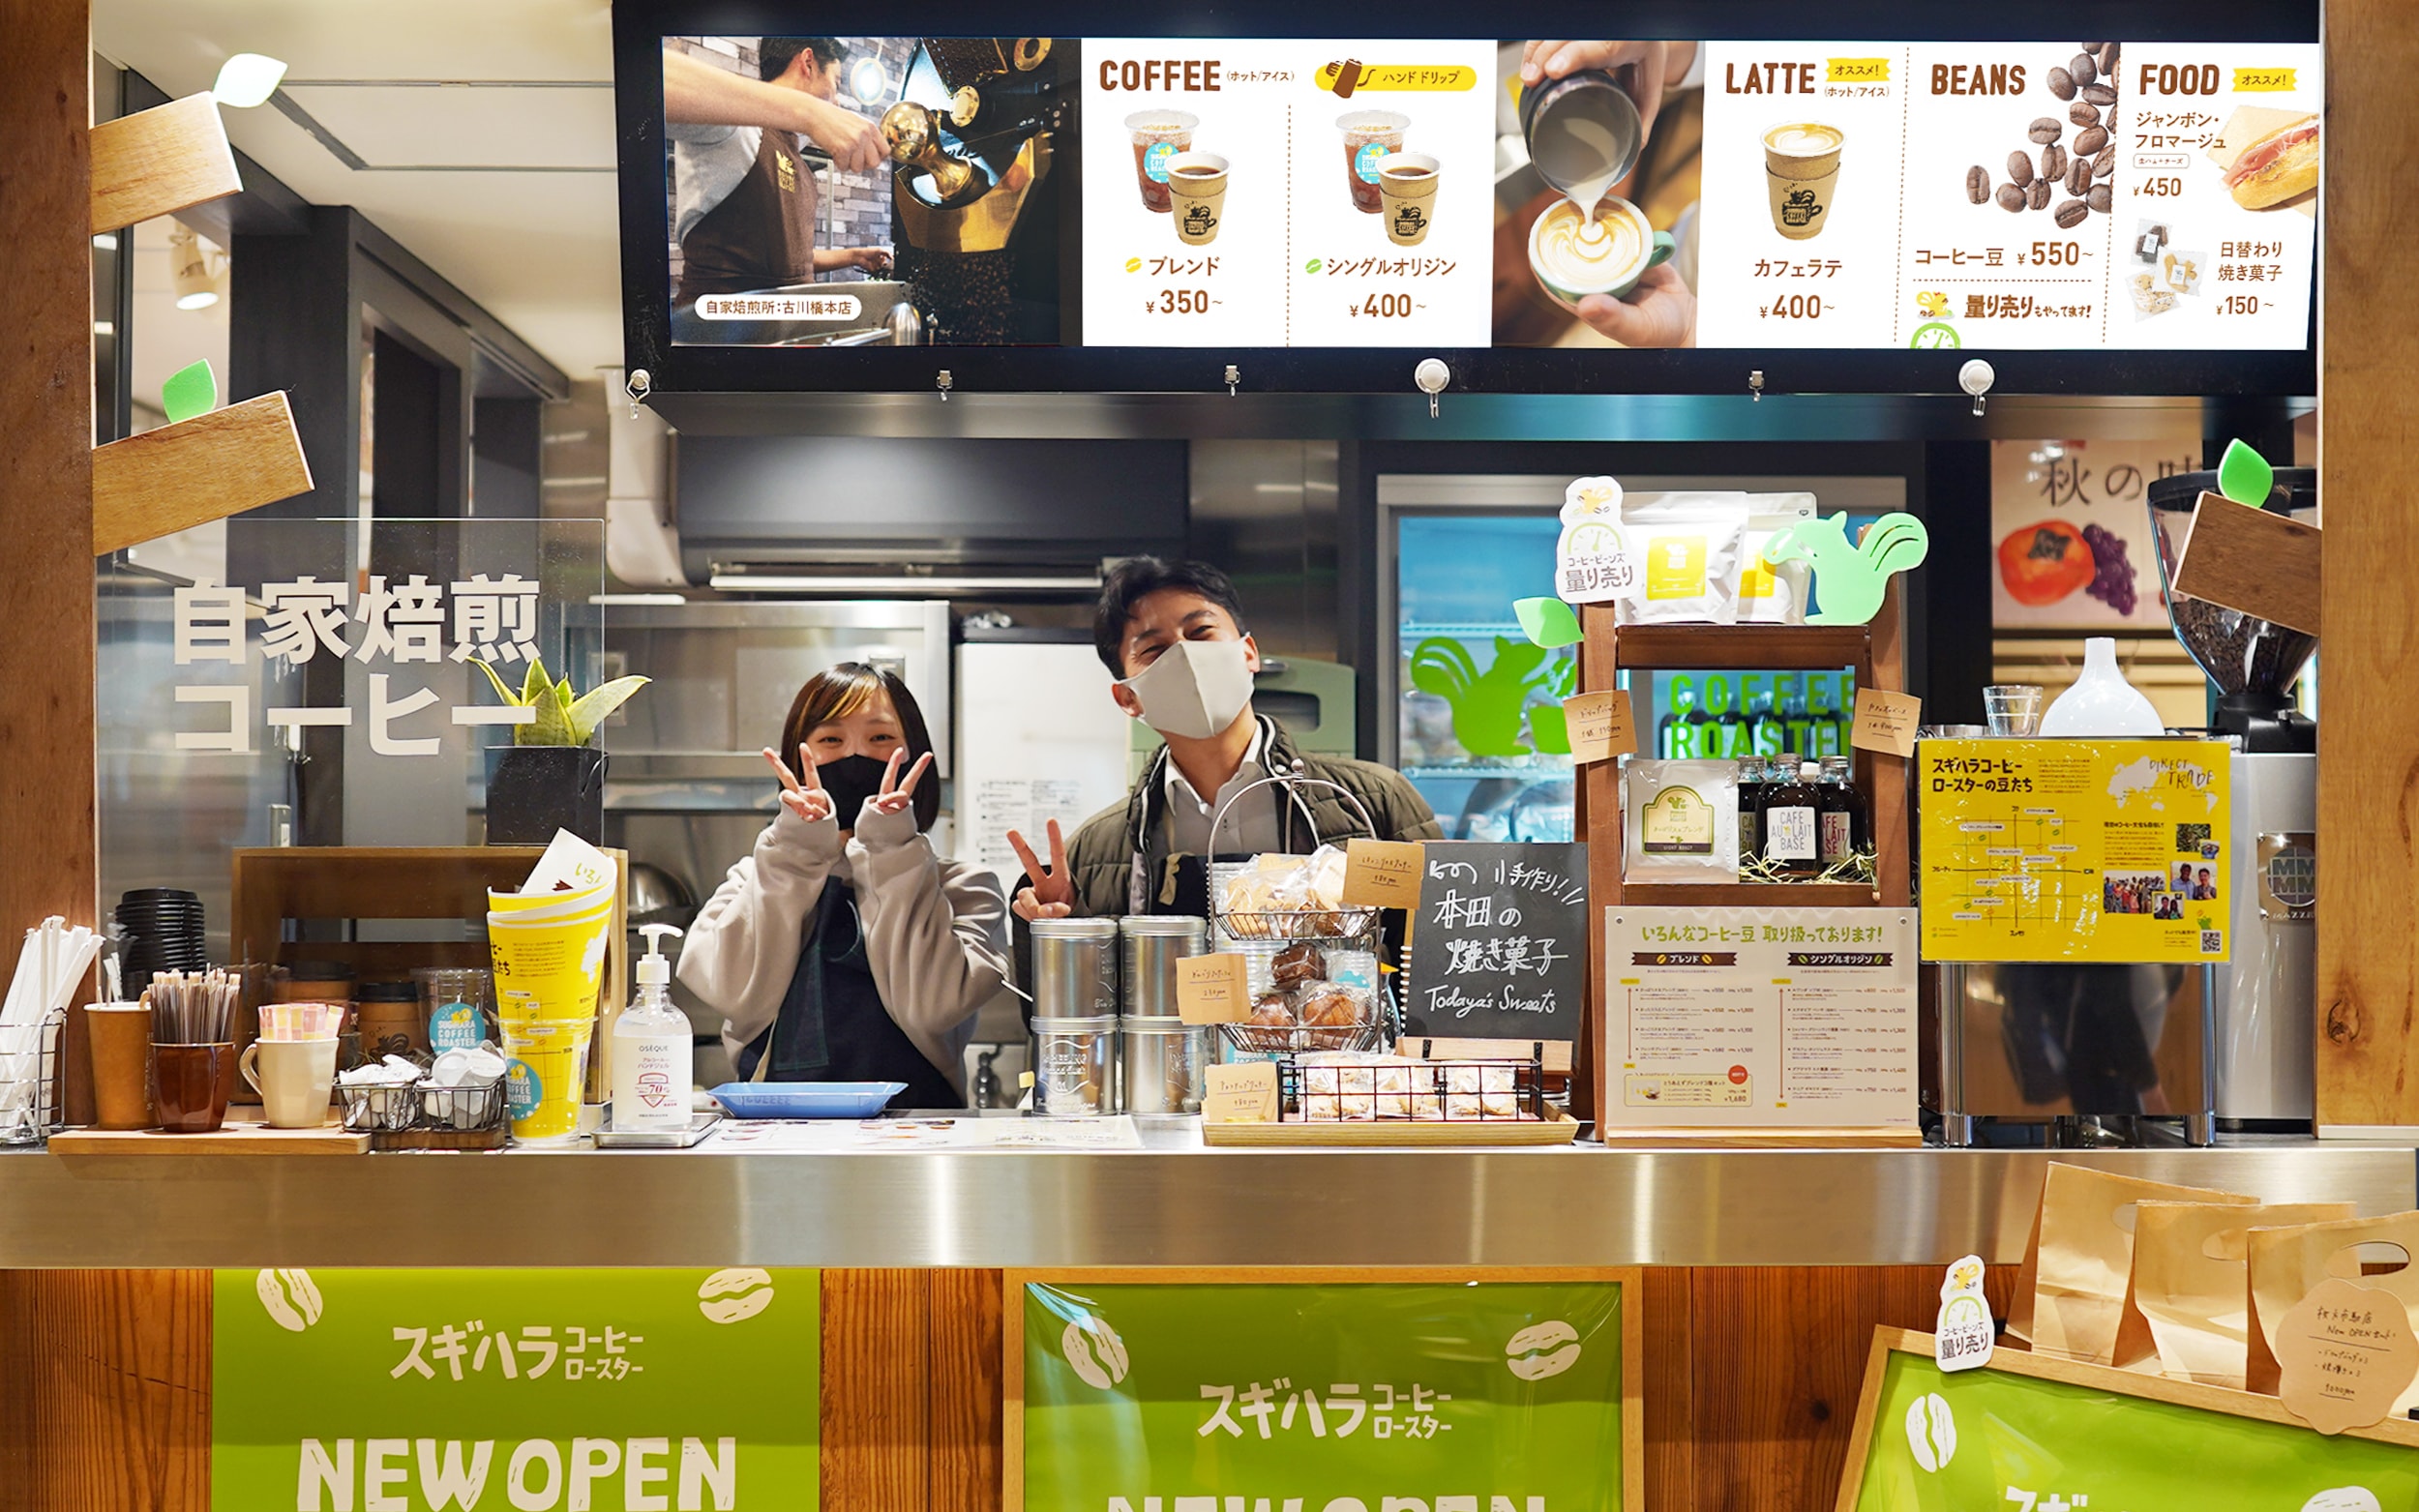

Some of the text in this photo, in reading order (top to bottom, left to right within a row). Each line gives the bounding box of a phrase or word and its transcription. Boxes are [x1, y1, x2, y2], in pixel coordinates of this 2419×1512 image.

[1100, 60, 1221, 92] COFFEE
[1725, 62, 1816, 95] LATTE
[1931, 64, 2026, 96] BEANS
[2139, 64, 2221, 96] FOOD
[2135, 133, 2226, 149] フロマージュ
[1915, 248, 2005, 266] コーヒー豆
[2221, 241, 2284, 258] 日替わり
[1148, 256, 1220, 277] ブレンド
[1327, 256, 1457, 278] シングルオリジン
[1753, 258, 1843, 279] カフェラテ
[2217, 264, 2284, 282] 焼き菓子
[1565, 565, 1633, 593] 量り売り
[173, 574, 541, 666] 自家焙煎
[174, 673, 537, 756] コーヒー
[1932, 757, 2023, 774] スギハラコーヒー
[2149, 758, 2189, 772] DIRECT
[1931, 777, 2033, 793] ロースターの豆たち
[1779, 811, 1805, 824] CAFE
[1792, 824, 1812, 838] LAIT
[1780, 838, 1806, 851] BASE
[1642, 925, 1756, 944] いろんなコーヒー豆
[1445, 935, 1569, 977] 焼き菓子
[1669, 954, 1700, 964] ブレンド
[1810, 954, 1873, 965] シングルオリジン
[1499, 984, 1557, 1014] Sweets
[437, 1028, 476, 1038] COFFEE
[437, 1037, 477, 1047] ROASTER
[390, 1319, 644, 1381] スギハラ コーヒー
[1941, 1332, 1988, 1360] 量り売り
[565, 1357, 643, 1381] ロースター
[1197, 1377, 1452, 1440] スギハラ コーヒー
[1373, 1415, 1452, 1440] ロースター
[296, 1437, 737, 1512] NEW OPEN
